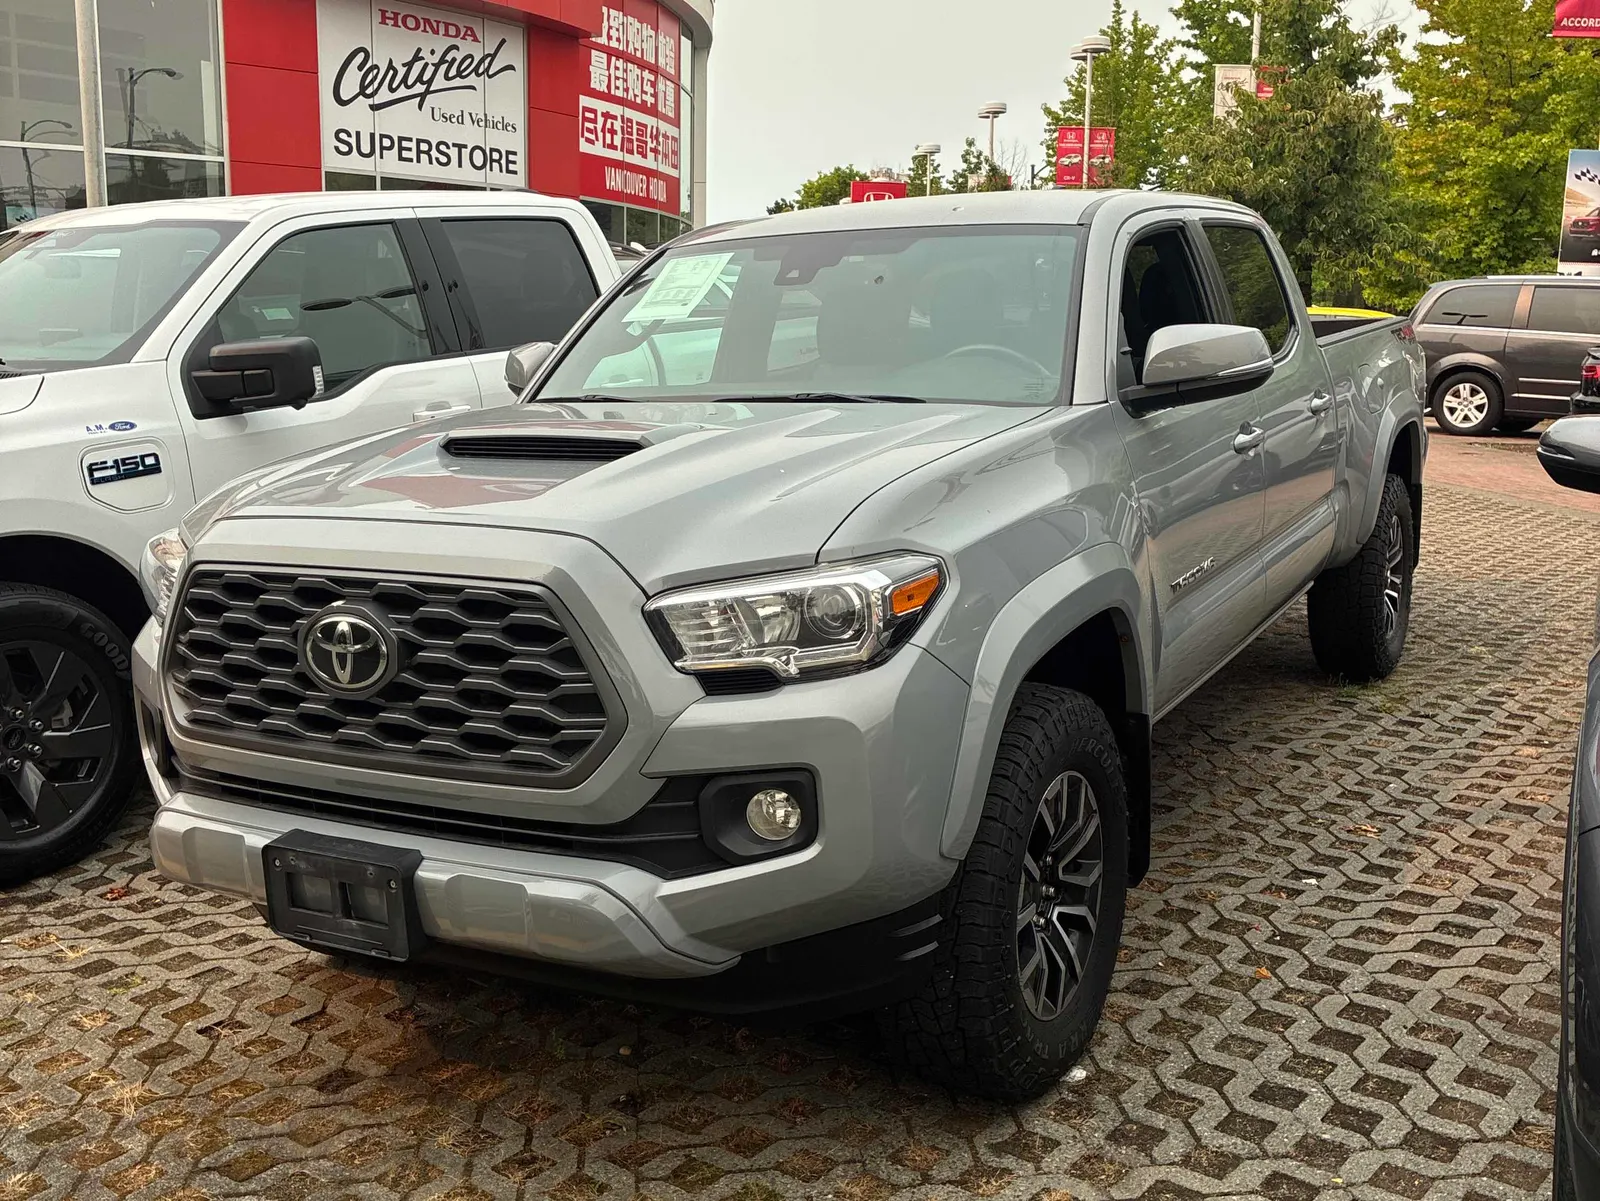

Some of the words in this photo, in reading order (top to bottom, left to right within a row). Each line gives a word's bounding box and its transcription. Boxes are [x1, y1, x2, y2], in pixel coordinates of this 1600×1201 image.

[378, 9, 481, 43] HONDA
[1560, 17, 1600, 27] ACCORD
[333, 38, 516, 111] Certified
[589, 49, 675, 119] 最佳购车优惠
[430, 106, 465, 126] Used
[468, 111, 517, 134] Vehicles
[333, 128, 518, 175] SUPERSTORE
[581, 105, 679, 171] 尽在温哥华本田
[604, 165, 648, 198] VANCOUVER
[86, 452, 161, 479] F-150
